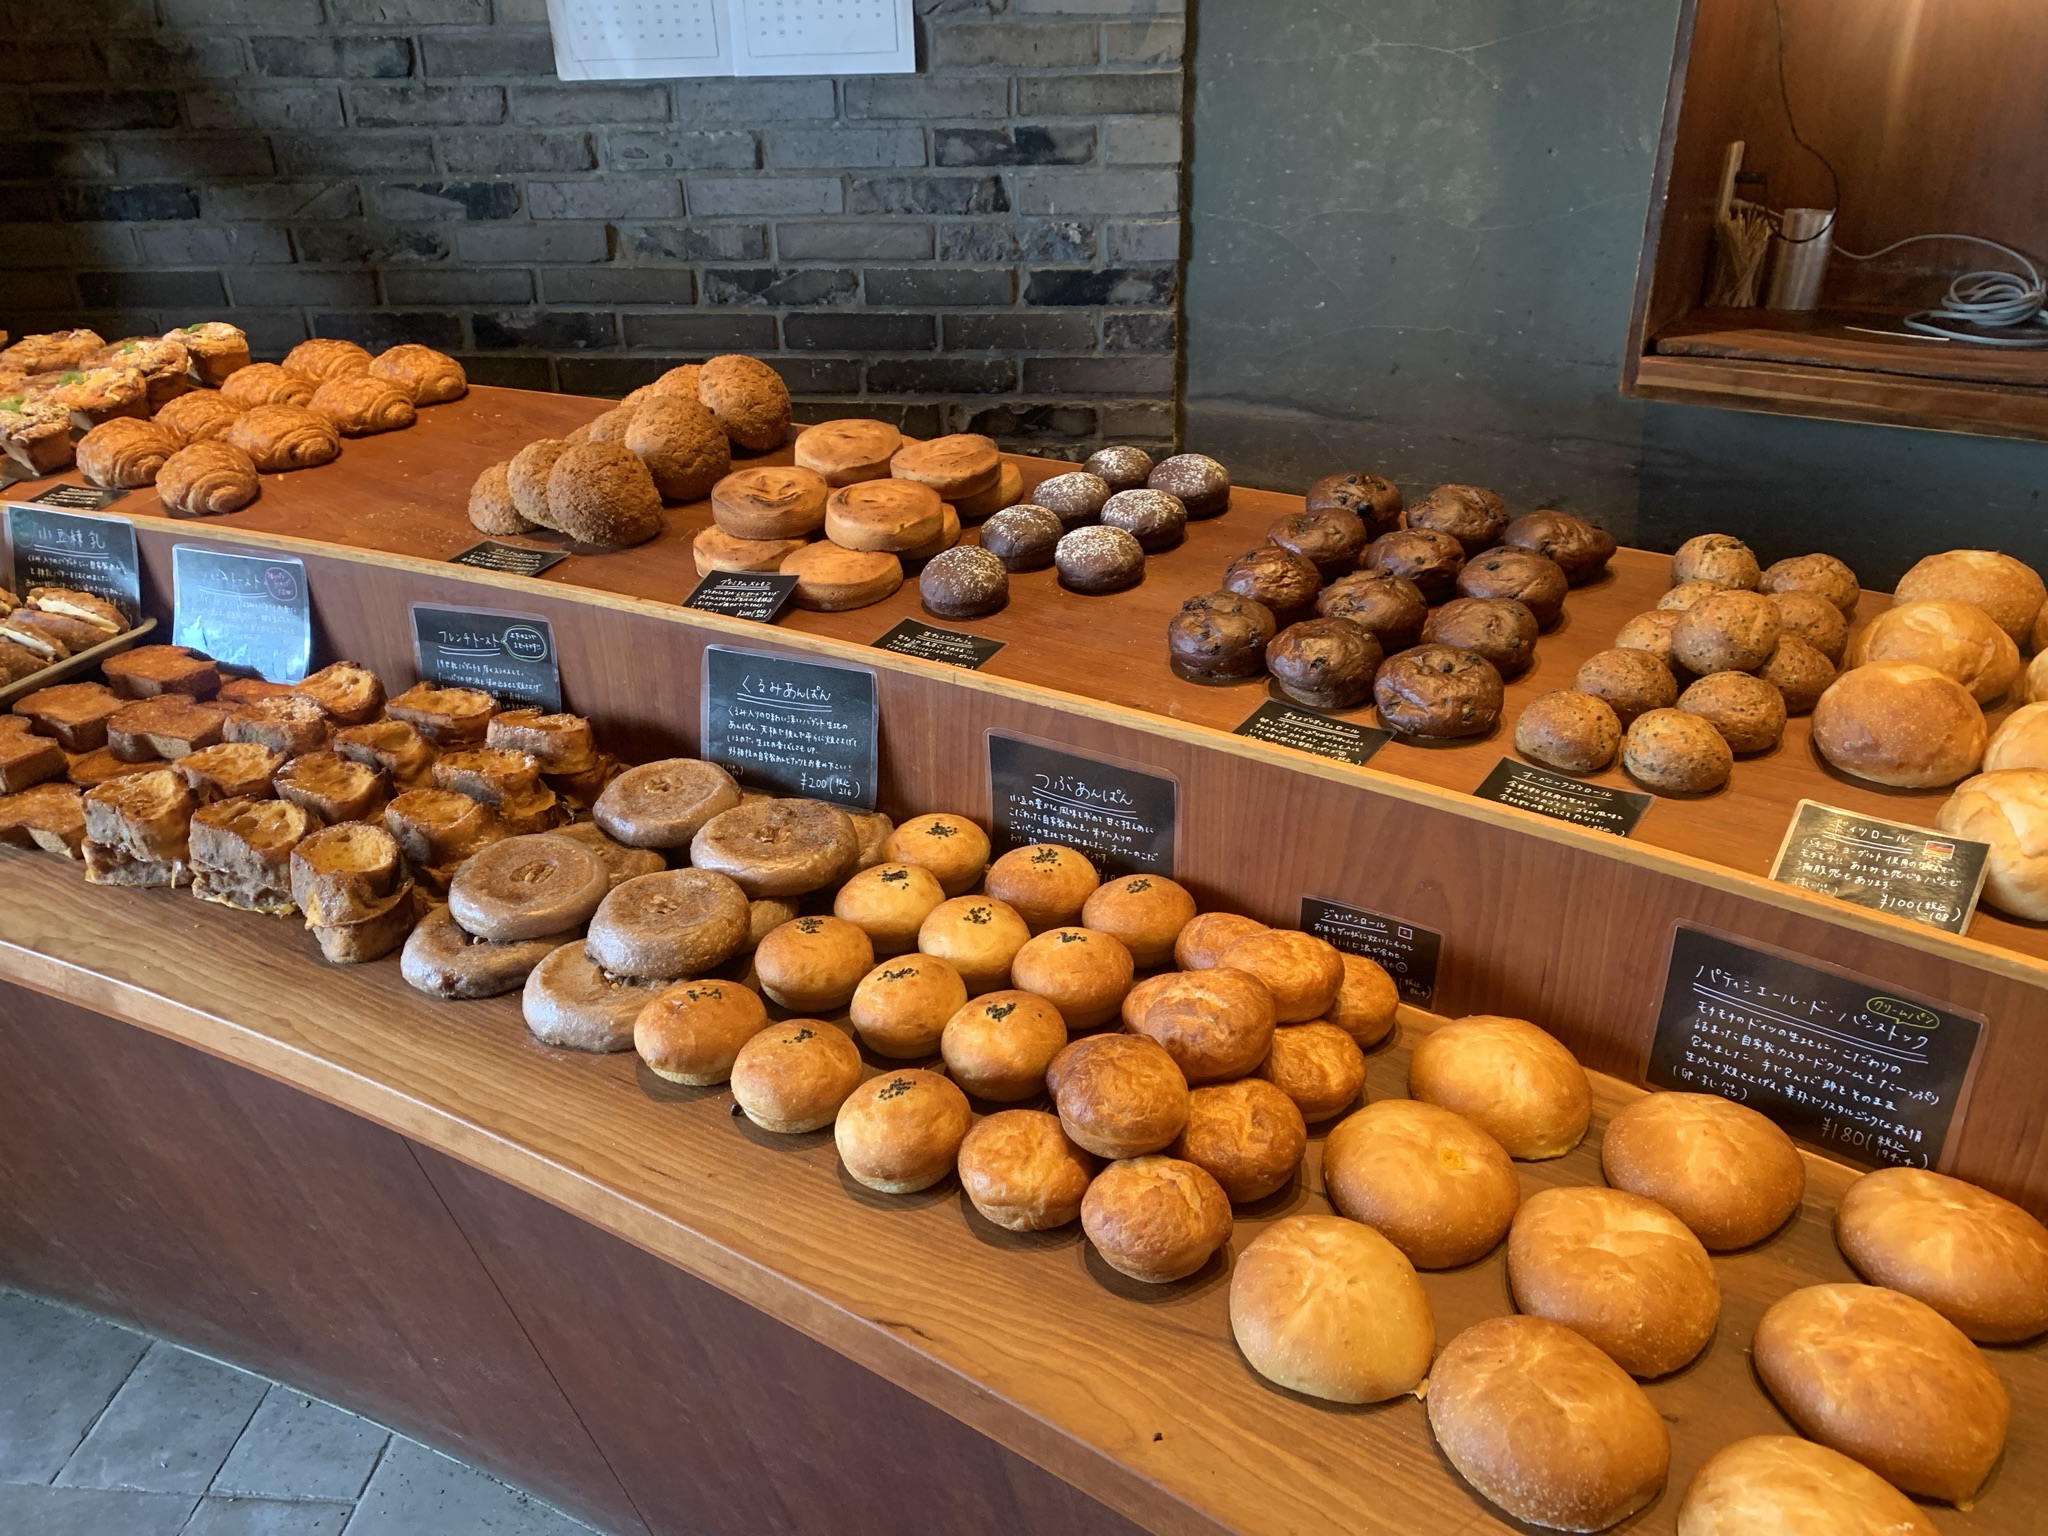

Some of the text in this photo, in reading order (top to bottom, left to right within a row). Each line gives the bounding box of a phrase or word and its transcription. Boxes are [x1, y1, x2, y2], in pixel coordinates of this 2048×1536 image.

[438, 631, 500, 648] フレンチトースト
[742, 675, 831, 701] くるみあんぱん
[1035, 774, 1133, 805] つぶあんぱん
[1835, 819, 1910, 845] ドイツロール
[1323, 908, 1386, 929] ジャパンロール
[1874, 1000, 1933, 1025] クリームパン
